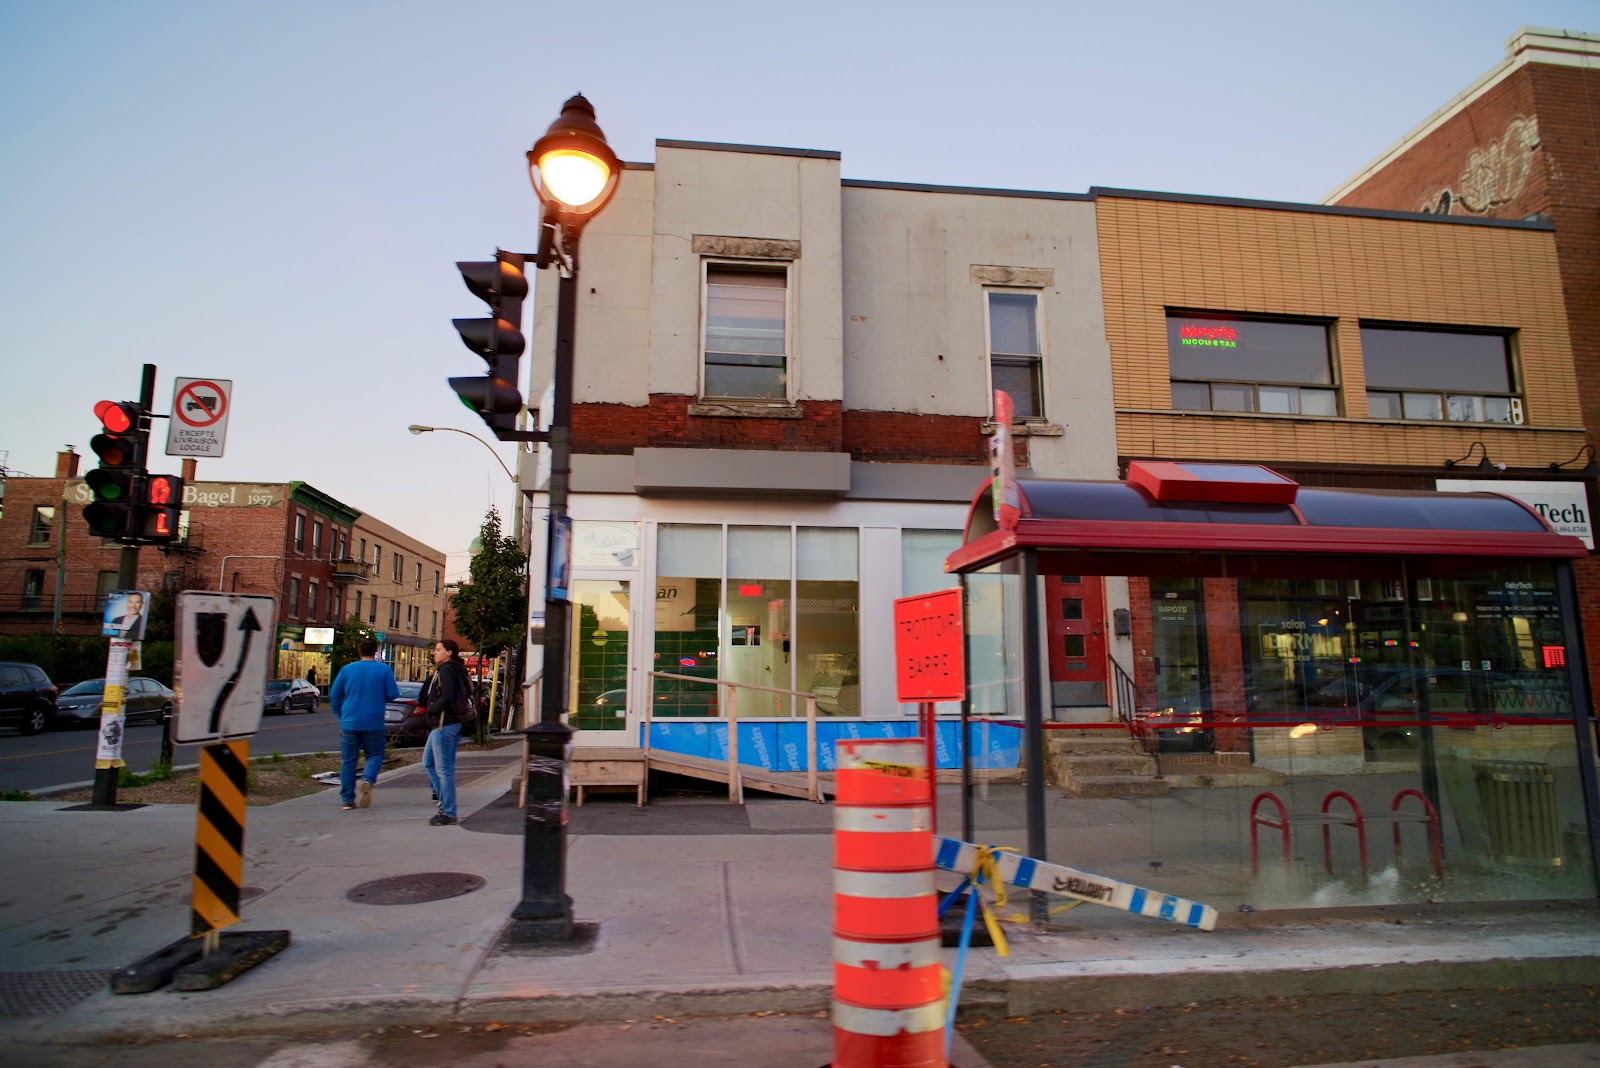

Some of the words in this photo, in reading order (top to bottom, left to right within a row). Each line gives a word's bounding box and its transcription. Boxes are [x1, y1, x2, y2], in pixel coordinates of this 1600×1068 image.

[174, 437, 218, 445] LIVRAISON
[180, 444, 211, 452] LOCALE
[251, 487, 270, 495] depuis
[182, 486, 236, 507] Bagel
[248, 495, 273, 506] 1957
[1534, 503, 1586, 523] Tech
[1281, 619, 1306, 629] salon
